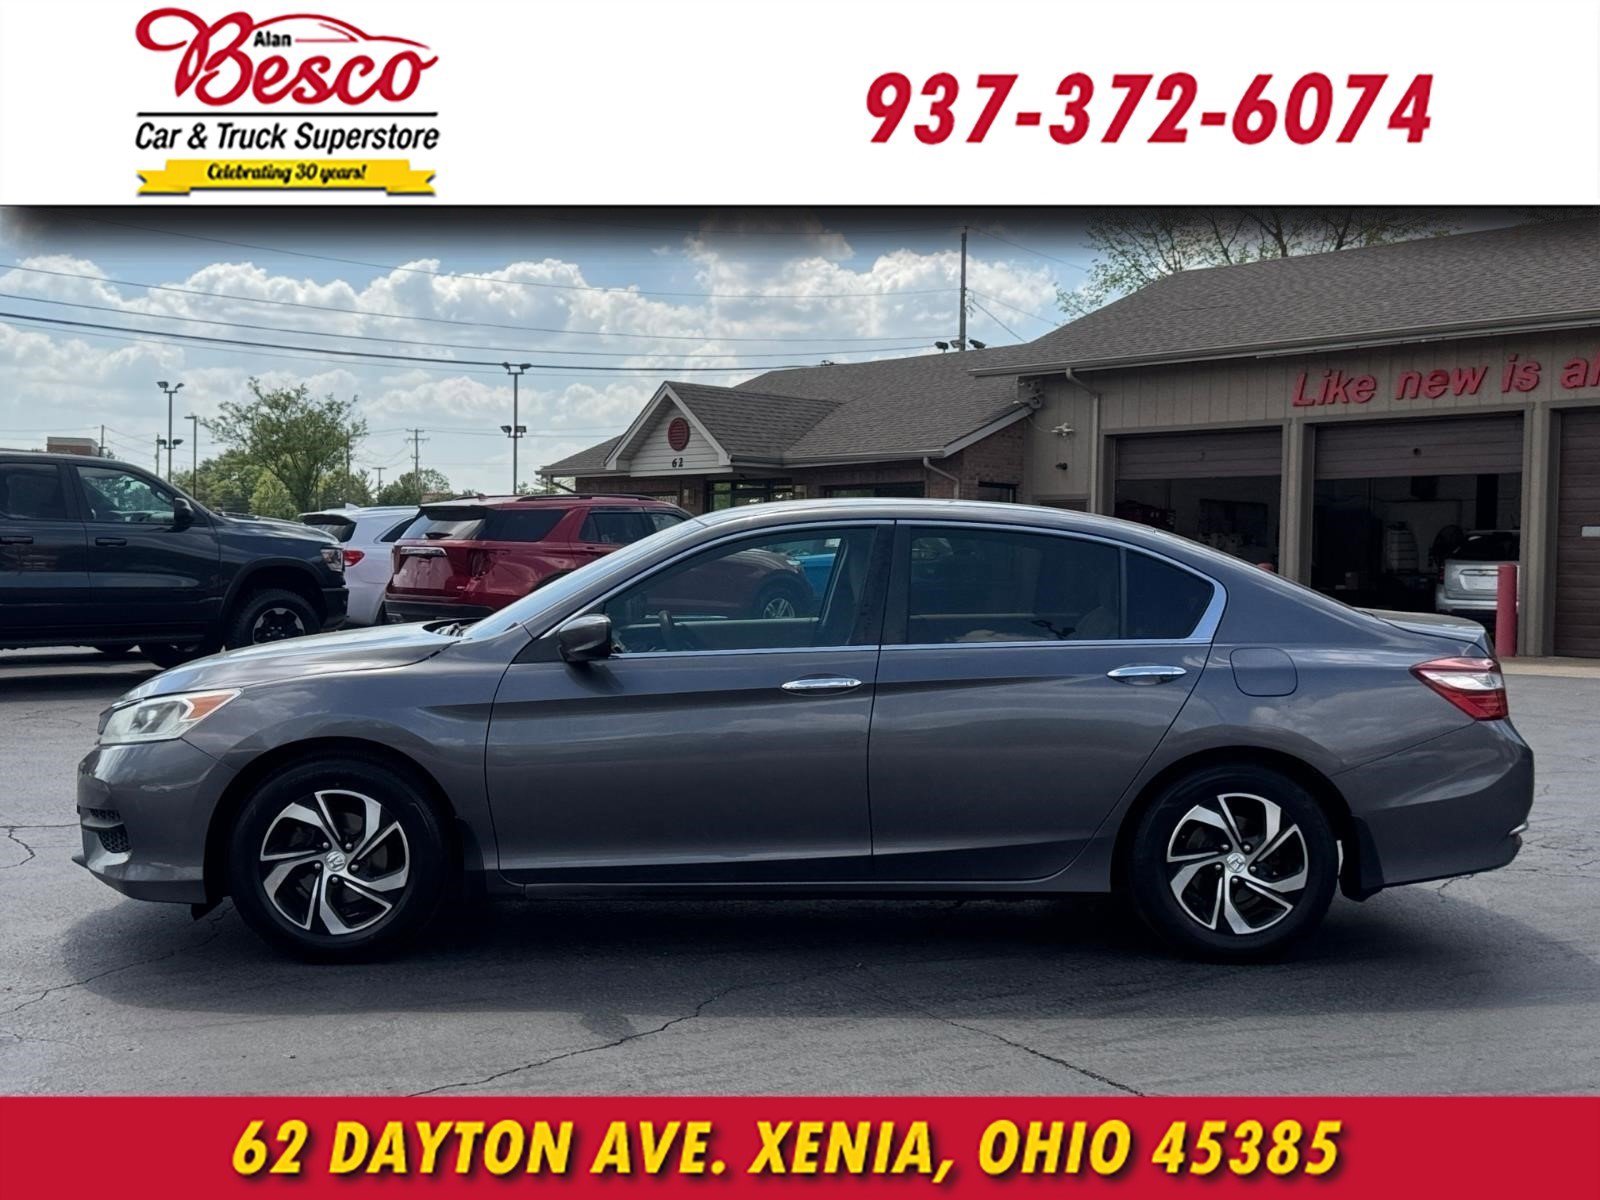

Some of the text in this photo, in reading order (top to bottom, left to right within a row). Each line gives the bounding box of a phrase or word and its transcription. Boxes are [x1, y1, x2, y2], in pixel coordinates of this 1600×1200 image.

[1292, 370, 1377, 407] Like
[1395, 368, 1488, 400] new
[1501, 354, 1542, 393] is
[672, 458, 684, 468] 62
